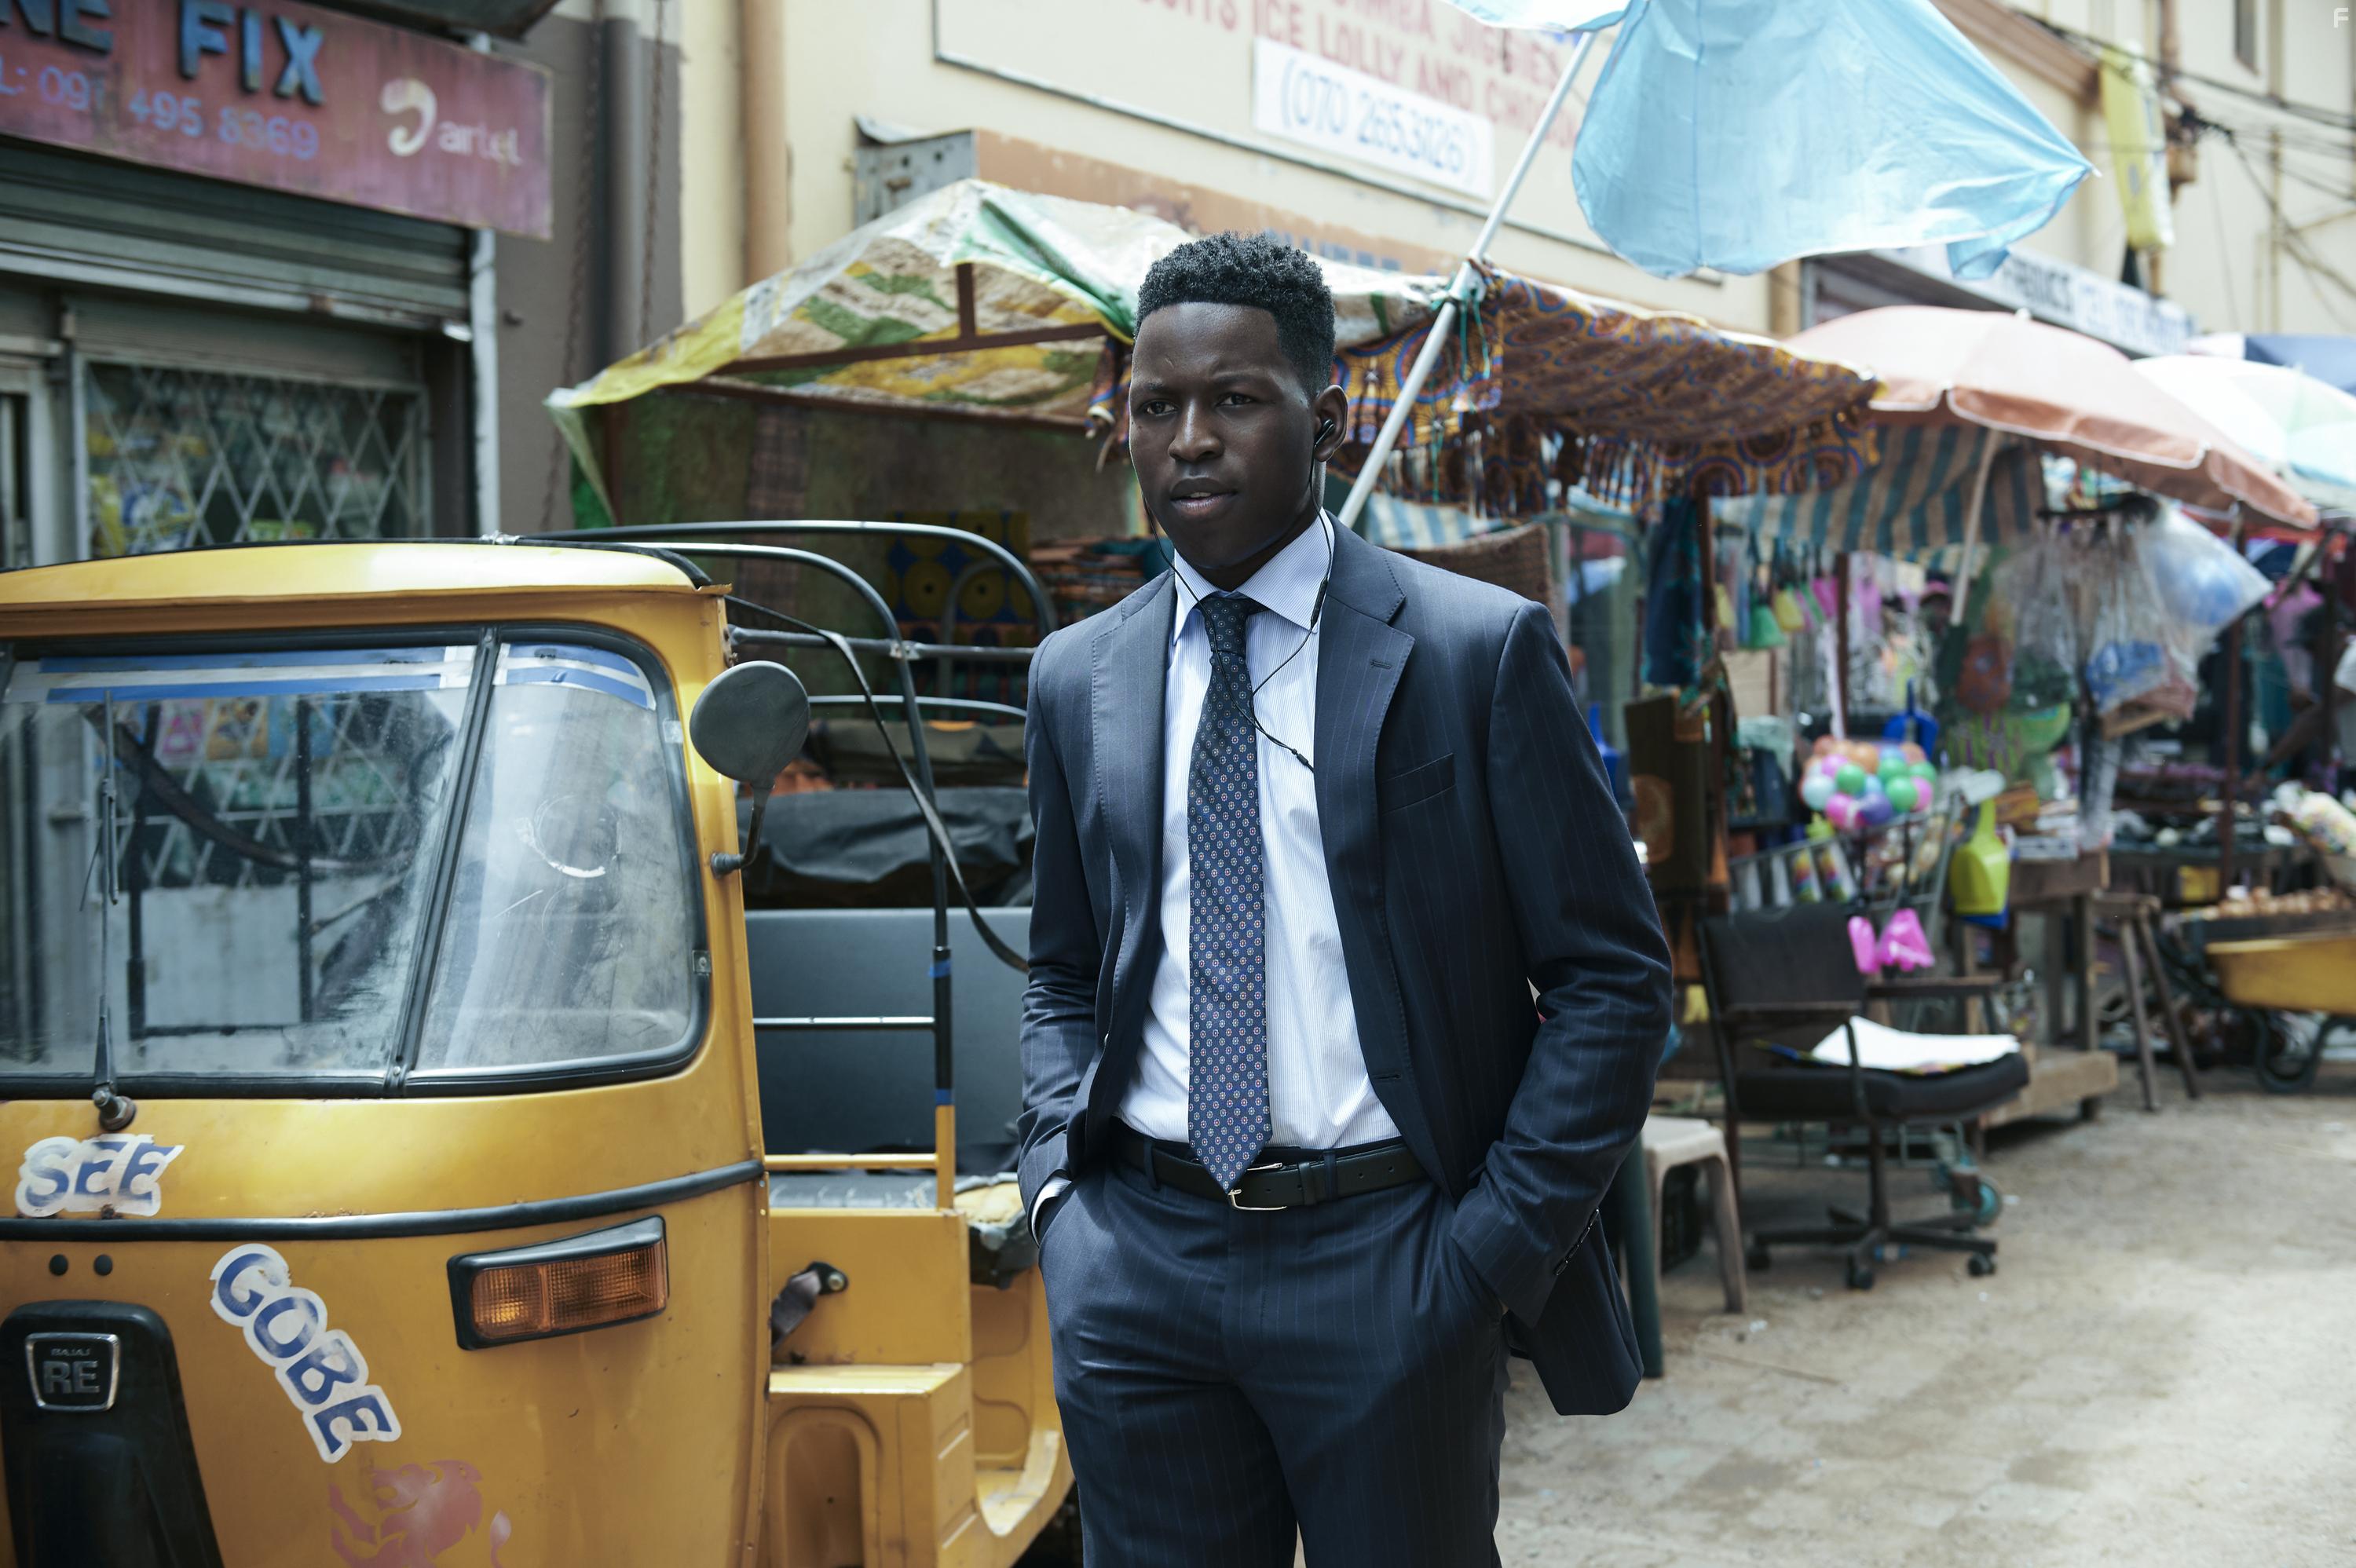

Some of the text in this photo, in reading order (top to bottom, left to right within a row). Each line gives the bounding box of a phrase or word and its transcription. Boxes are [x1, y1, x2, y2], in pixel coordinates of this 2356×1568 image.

[179, 0, 324, 104] FIX
[129, 88, 204, 136] 495
[218, 105, 320, 159] 8369
[24, 1140, 176, 1208] SEE
[42, 1360, 101, 1394] RE
[217, 1252, 393, 1454] GOBE
